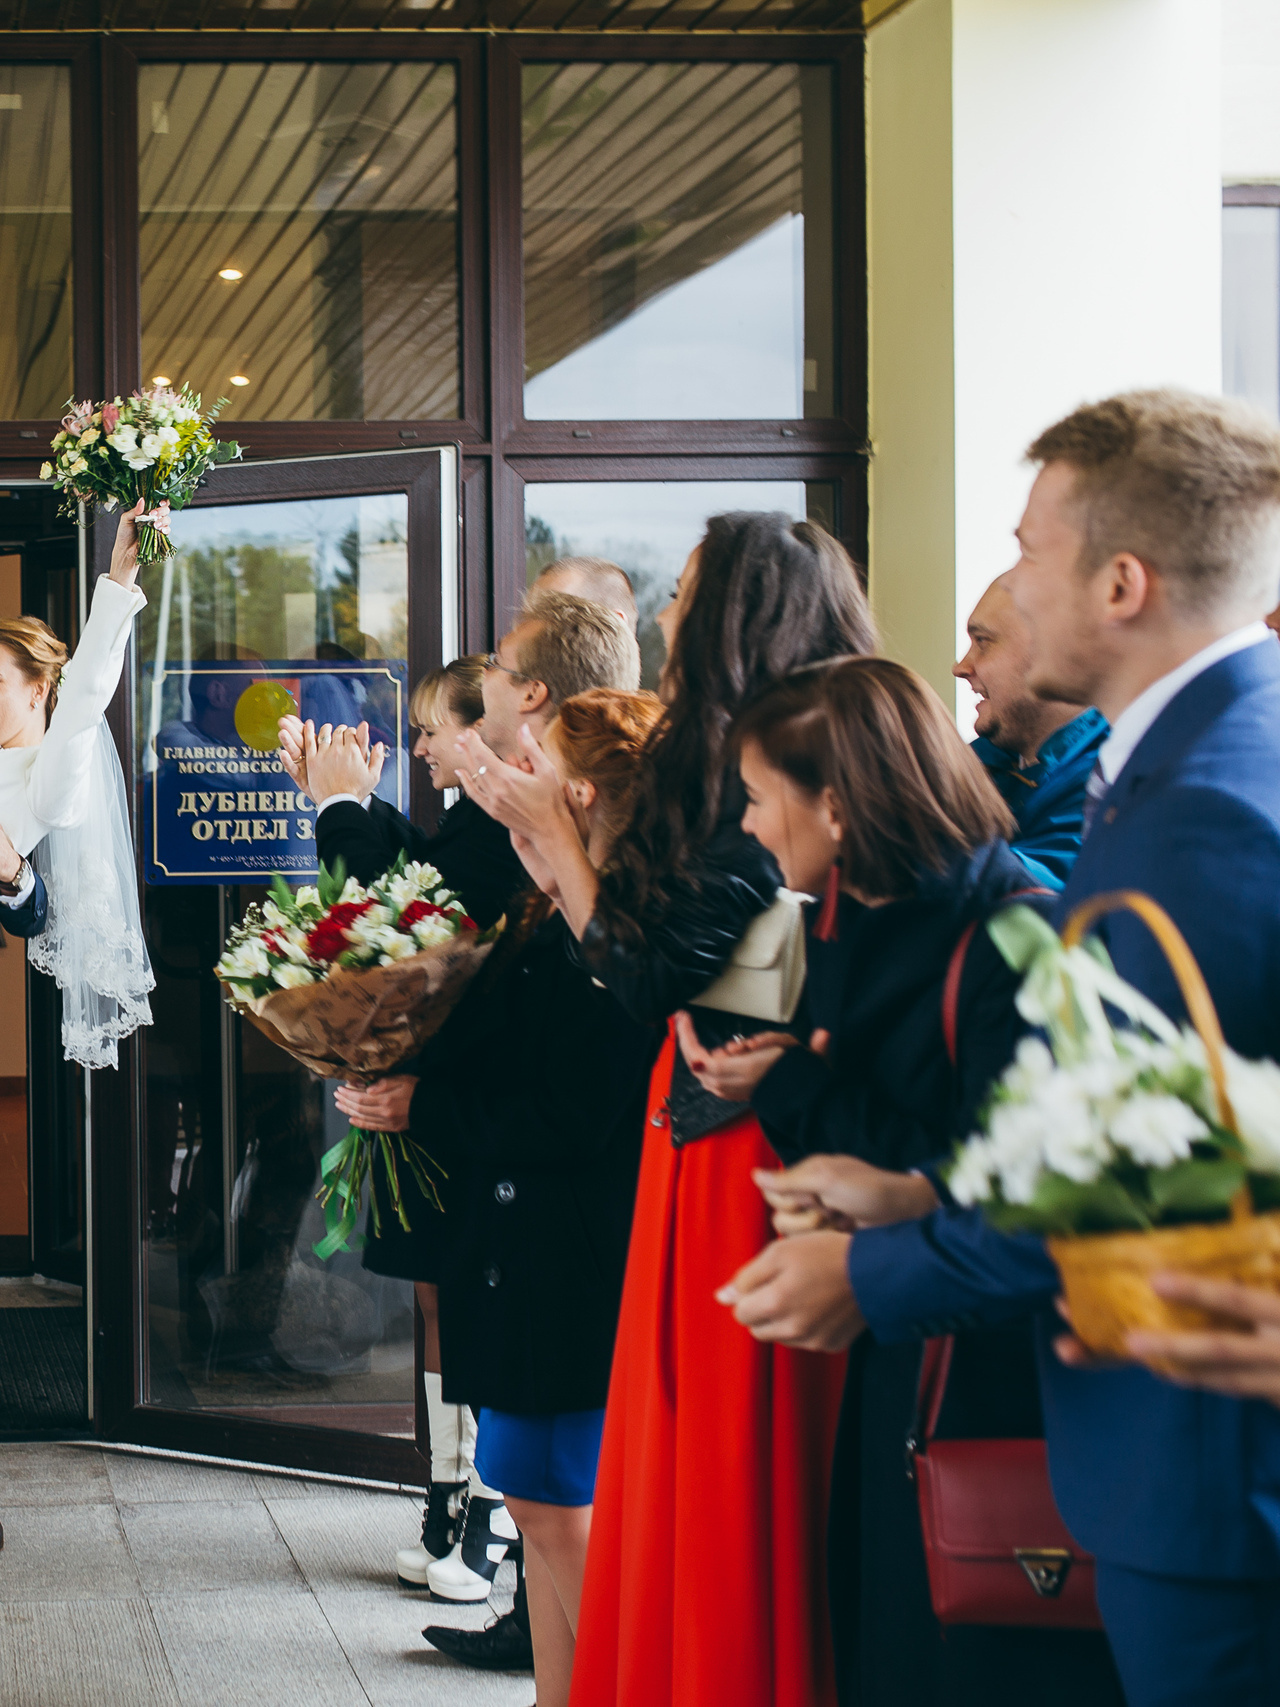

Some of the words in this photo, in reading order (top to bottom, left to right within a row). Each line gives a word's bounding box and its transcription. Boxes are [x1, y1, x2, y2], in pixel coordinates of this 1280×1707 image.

[163, 745, 238, 759] ГЛАВНОЕ
[178, 761, 289, 774] МОСКОВСКО
[177, 791, 318, 817] ДУБНЕНС
[191, 819, 289, 844] ОТДЕЛ
